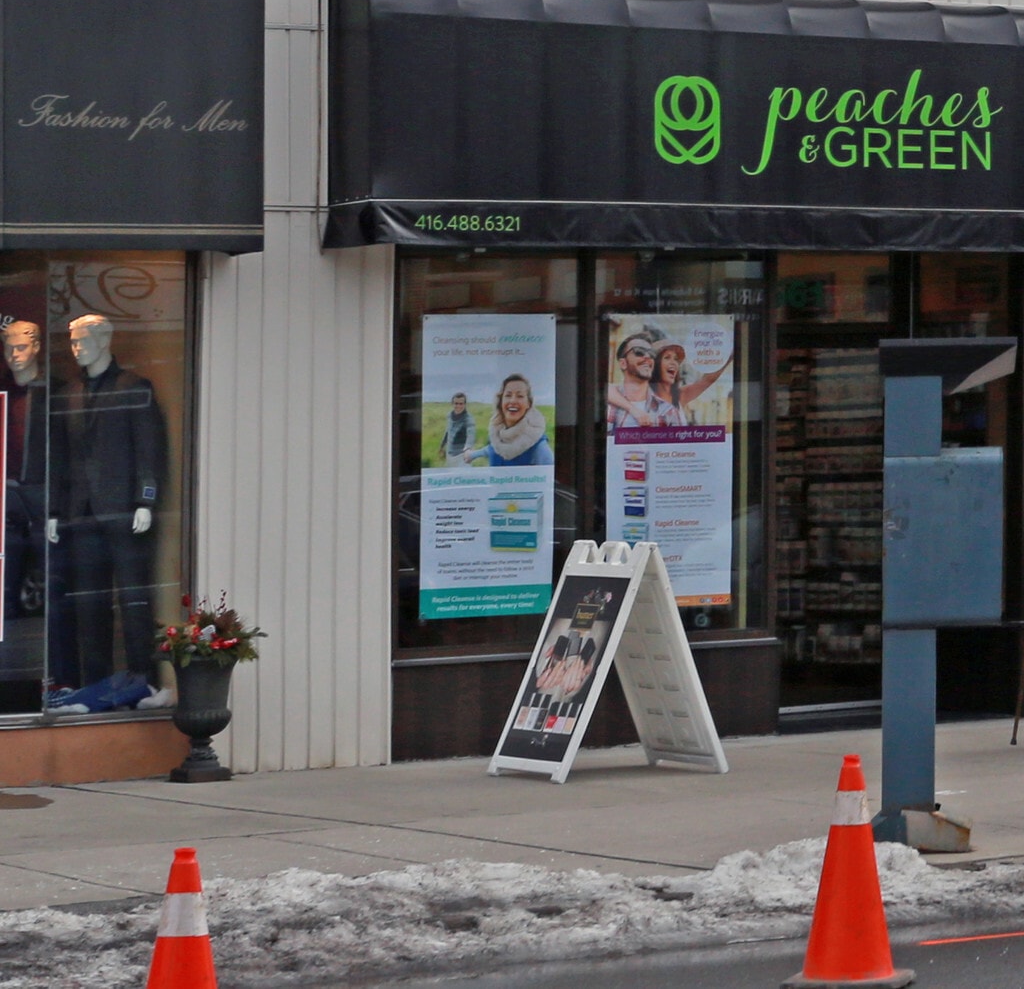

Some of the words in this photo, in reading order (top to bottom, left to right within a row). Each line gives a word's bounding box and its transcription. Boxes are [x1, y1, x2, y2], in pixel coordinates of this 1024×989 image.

[18, 94, 130, 128] Fashion
[128, 100, 175, 141] for
[181, 99, 249, 132] Men
[741, 68, 1003, 176] peaches
[414, 214, 521, 232] 416.488.6321
[694, 330, 724, 340] Energize
[432, 335, 469, 346] Cleansing
[471, 335, 497, 344] should
[432, 349, 450, 357] your
[480, 348, 514, 357] interrupt
[675, 430, 692, 440] right
[694, 430, 704, 438] for
[705, 430, 723, 440] you?
[672, 450, 697, 458] Cleanse
[427, 477, 452, 487] Rapid
[489, 475, 513, 485] Rapid
[515, 475, 547, 484] Results!
[654, 520, 673, 529] Rapid
[674, 519, 700, 528] Cleanse
